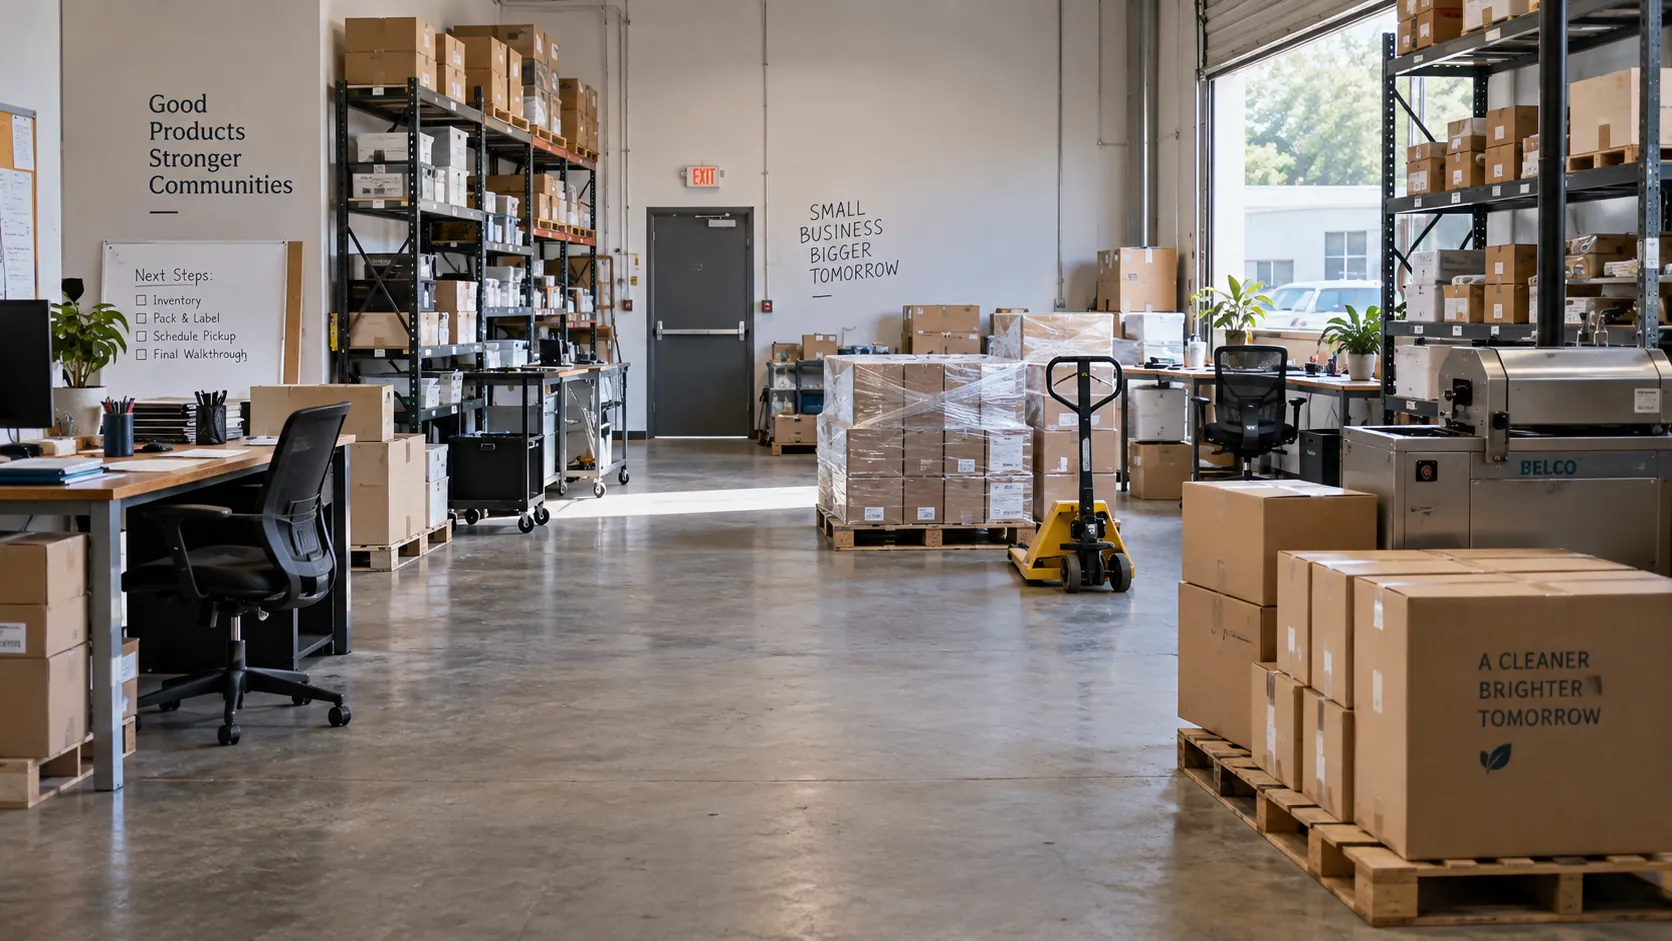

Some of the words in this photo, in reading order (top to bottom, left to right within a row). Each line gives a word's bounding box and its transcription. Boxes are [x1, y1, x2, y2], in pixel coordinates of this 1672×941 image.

[149, 93, 207, 114] Good
[149, 121, 246, 141] Products
[149, 148, 242, 172] Stronger
[149, 174, 293, 195] Communities
[692, 167, 716, 186] EXIT
[810, 200, 866, 221] SMALL
[800, 218, 884, 244] BUSINESS
[810, 241, 872, 264] BIGGER
[135, 268, 166, 283] Next
[173, 267, 214, 286] Steps:
[810, 259, 900, 285] TOMORROW
[153, 295, 202, 309] Inventory
[153, 312, 177, 324] Pack
[182, 313, 189, 324] &
[193, 312, 221, 324] Label
[153, 330, 199, 343] Schedule
[203, 330, 236, 345] Pickup
[153, 348, 179, 360] Final
[183, 348, 248, 363] Walkthrough
[1520, 459, 1577, 476] BELCO
[1478, 653, 1492, 671] A
[1499, 651, 1590, 671] CLEANER
[1479, 680, 1583, 700] BRIGHTER
[1478, 706, 1601, 728] TOMORROW
